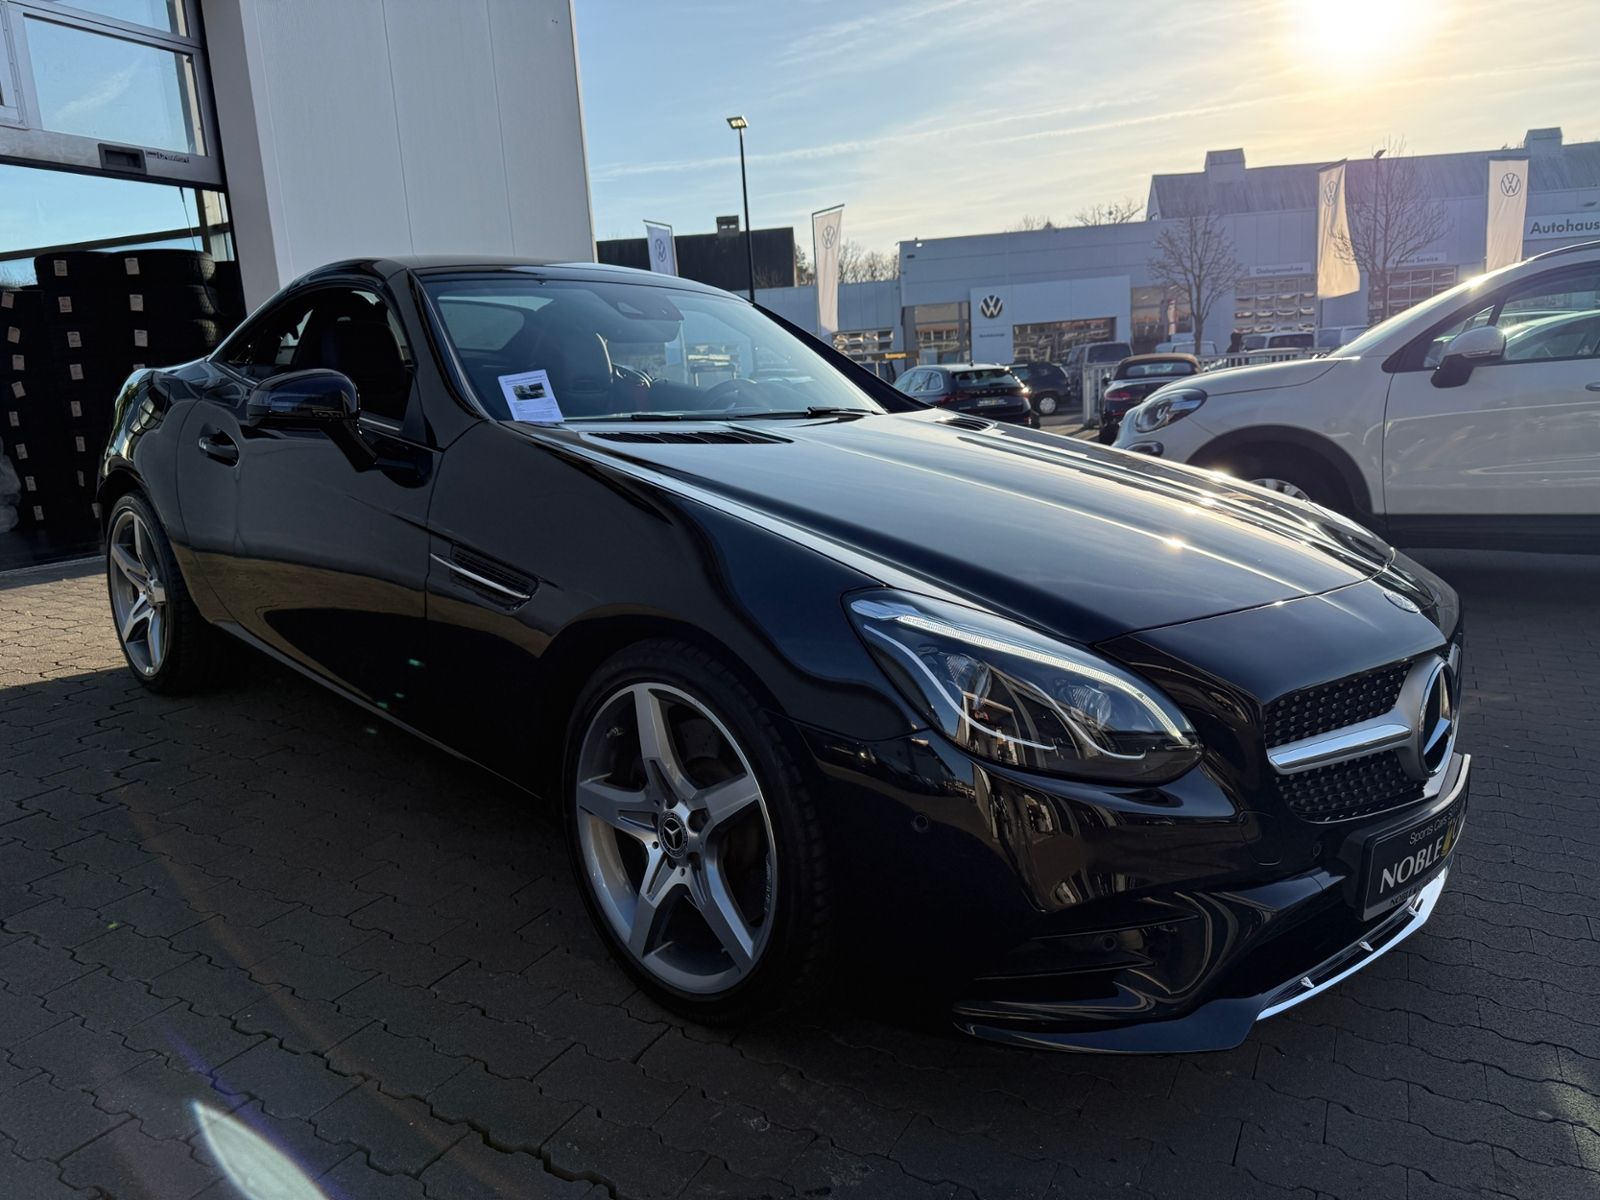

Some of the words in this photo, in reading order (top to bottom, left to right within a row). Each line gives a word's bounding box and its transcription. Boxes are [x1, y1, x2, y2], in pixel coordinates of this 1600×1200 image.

[1501, 173, 1521, 197] VW
[1530, 219, 1600, 235] Autohaus
[980, 294, 1004, 319] VW
[1409, 824, 1434, 846] Sports
